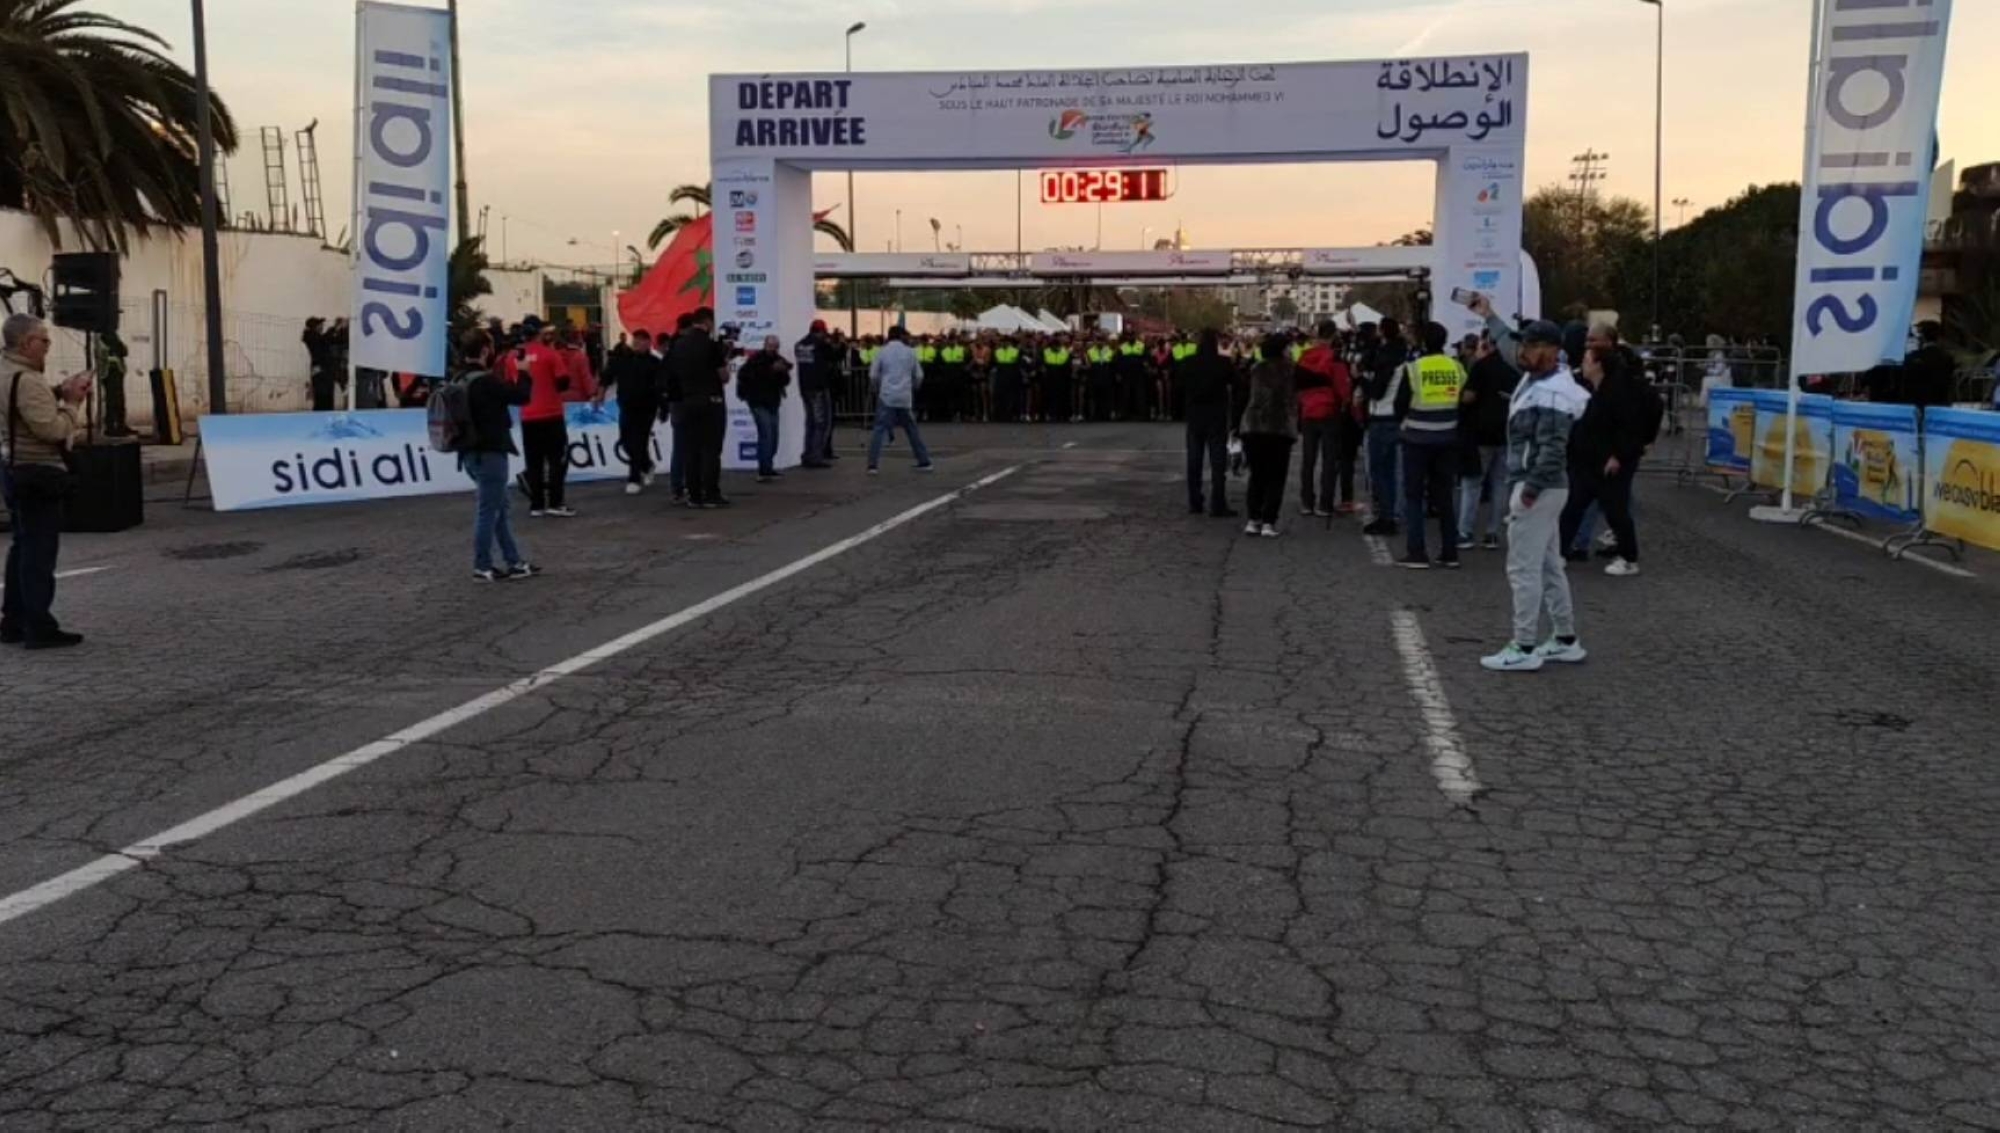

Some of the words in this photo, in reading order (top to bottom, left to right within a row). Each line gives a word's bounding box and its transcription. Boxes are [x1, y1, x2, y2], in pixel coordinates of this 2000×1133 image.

[738, 75, 852, 110] DÉPART
[939, 100, 968, 110] SOUS
[986, 99, 1014, 109] HAUT
[735, 109, 866, 147] ARRIVÉE
[1377, 99, 1512, 142] الوصول
[1042, 171, 1166, 202] 00:29:11
[1421, 369, 1459, 387] PRESSE
[271, 447, 362, 493] sidi
[372, 443, 430, 486] ali
